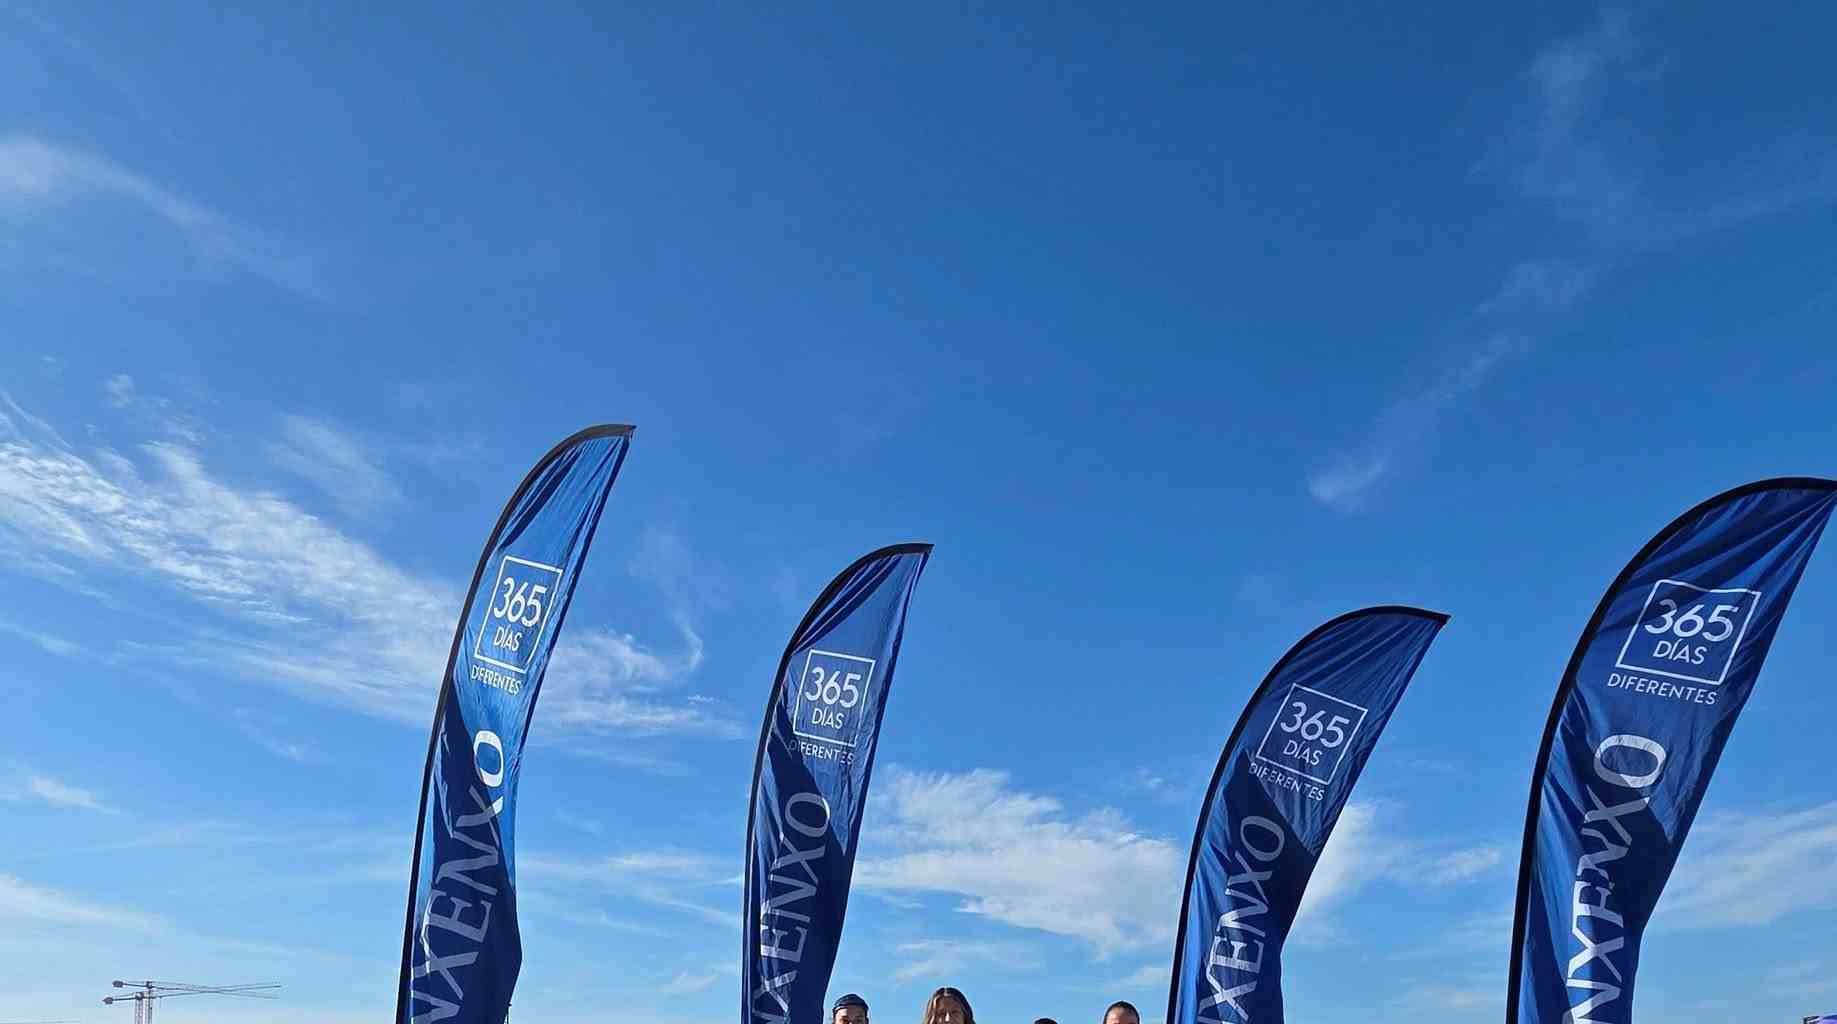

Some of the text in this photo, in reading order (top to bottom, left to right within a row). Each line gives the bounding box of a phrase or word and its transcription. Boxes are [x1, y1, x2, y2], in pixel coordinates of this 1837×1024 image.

[493, 576, 548, 628] 365
[1643, 598, 1739, 642] 365
[492, 625, 523, 652] DÍAS
[1653, 638, 1708, 665] DÍAS
[470, 664, 523, 697] DIFERENTES
[804, 666, 862, 708] 365
[1607, 673, 1718, 706] DIFERENTES
[811, 706, 845, 730] DÍAS
[1280, 701, 1350, 749] 365
[788, 738, 856, 766] DIFERENTES
[1283, 738, 1323, 766] DÍAS
[1249, 762, 1326, 802] DIFERENTES
